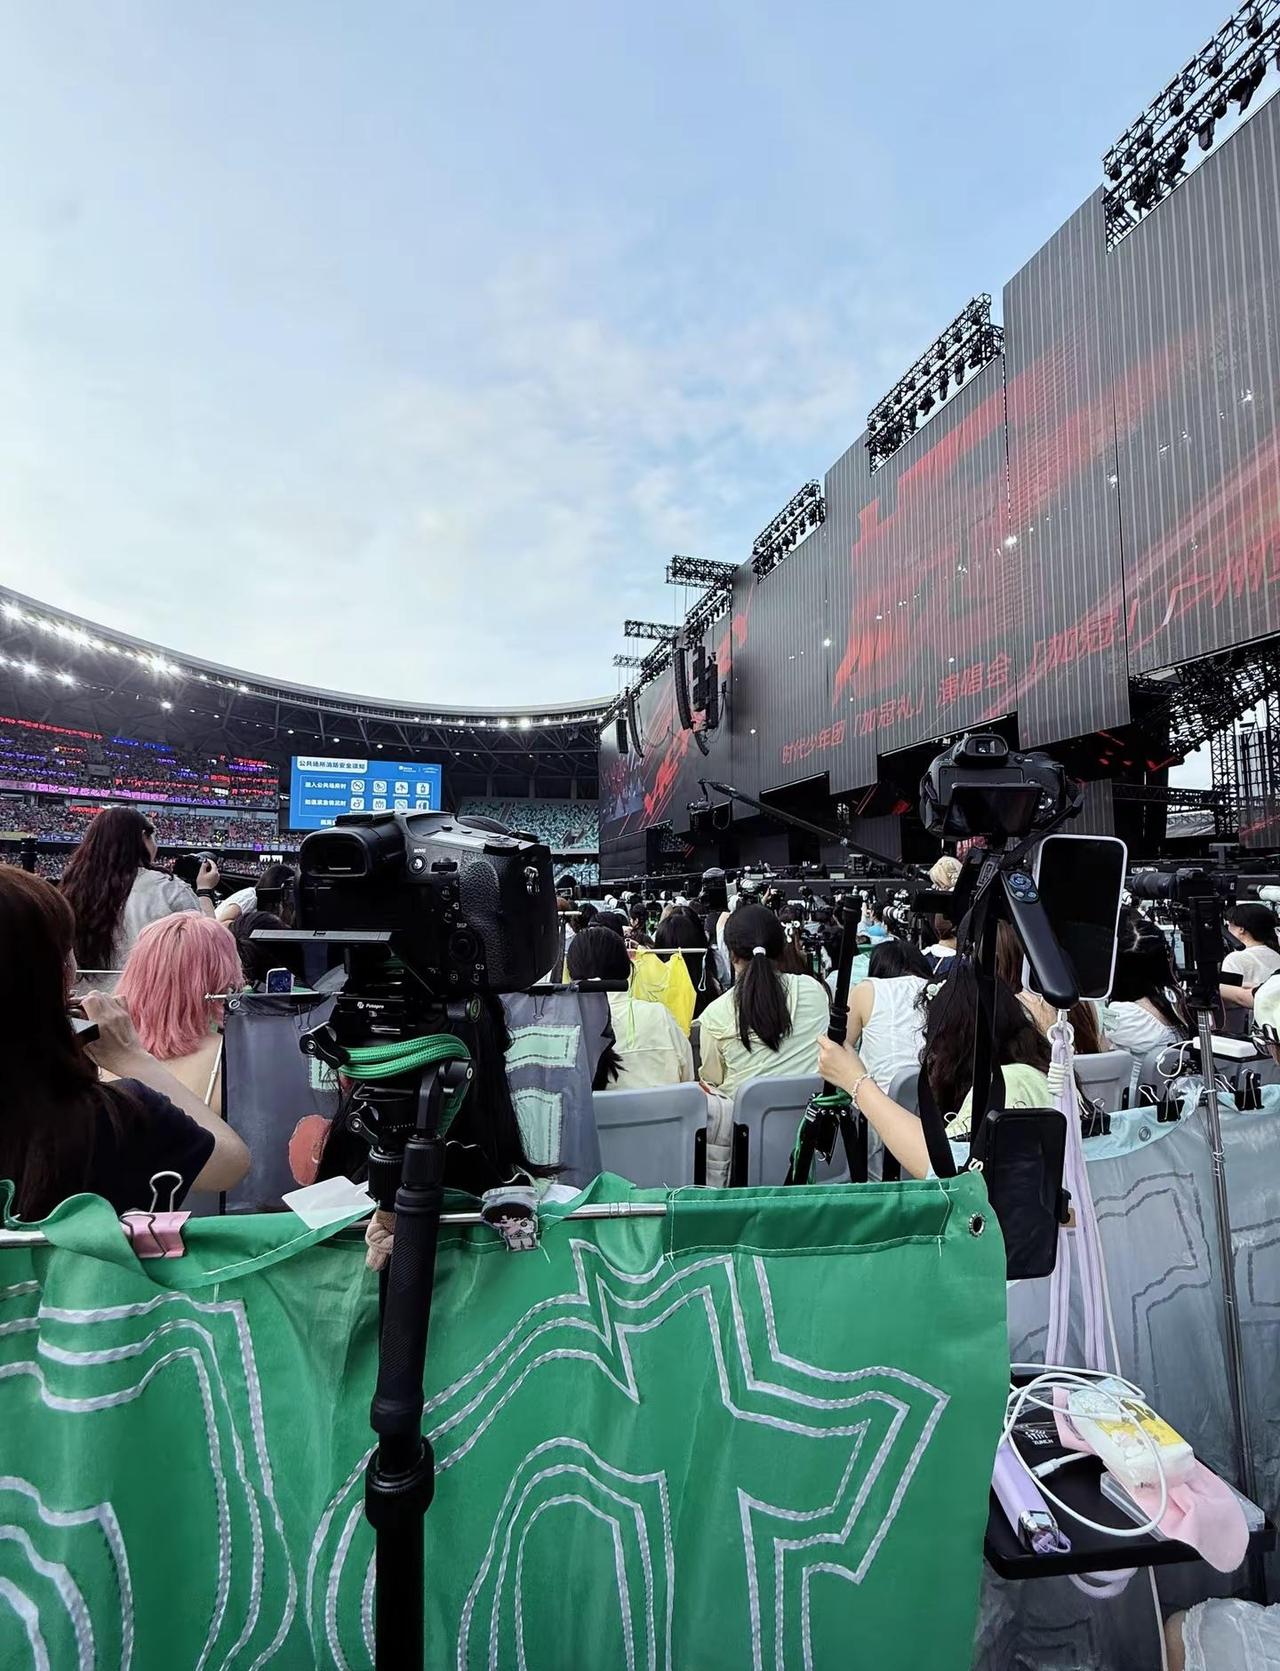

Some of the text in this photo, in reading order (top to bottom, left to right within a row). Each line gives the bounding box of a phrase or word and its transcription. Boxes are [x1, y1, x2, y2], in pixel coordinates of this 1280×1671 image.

[780, 719, 846, 765] 时代少年团
[937, 649, 1012, 707] 演唱会
